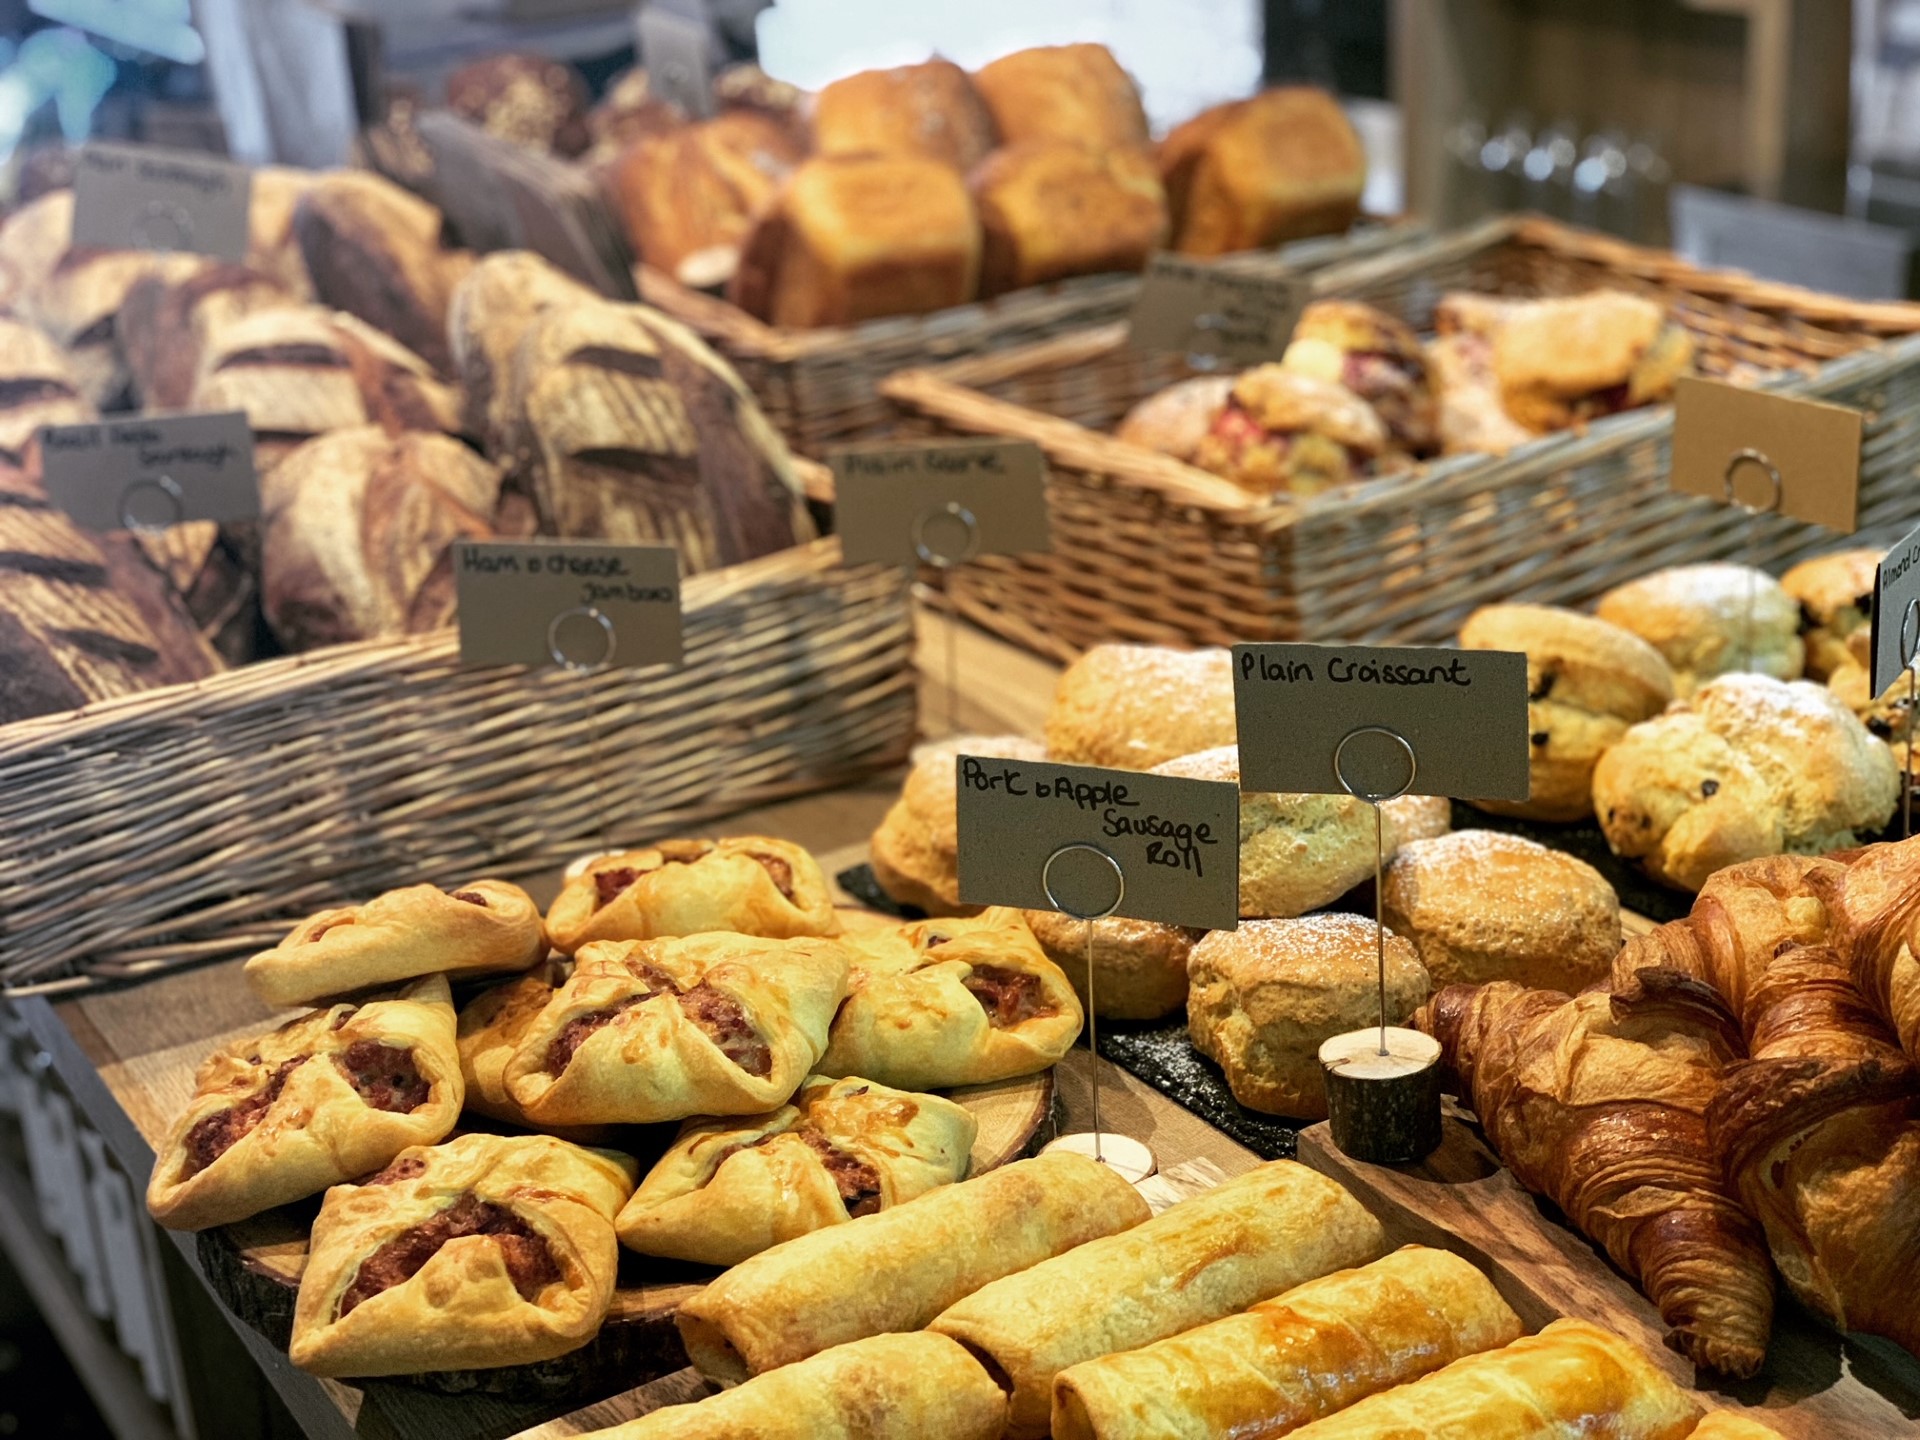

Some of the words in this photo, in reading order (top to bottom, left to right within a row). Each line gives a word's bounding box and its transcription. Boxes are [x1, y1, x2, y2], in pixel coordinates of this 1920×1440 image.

[463, 546, 519, 573] Ham
[1882, 548, 1911, 591] Almond
[1241, 651, 1314, 683] Plain
[1327, 656, 1472, 687] Croissant
[963, 758, 1028, 796] Pork
[1055, 777, 1141, 811] Apple
[1102, 808, 1218, 850] Sausage
[1146, 841, 1203, 877] Roll
